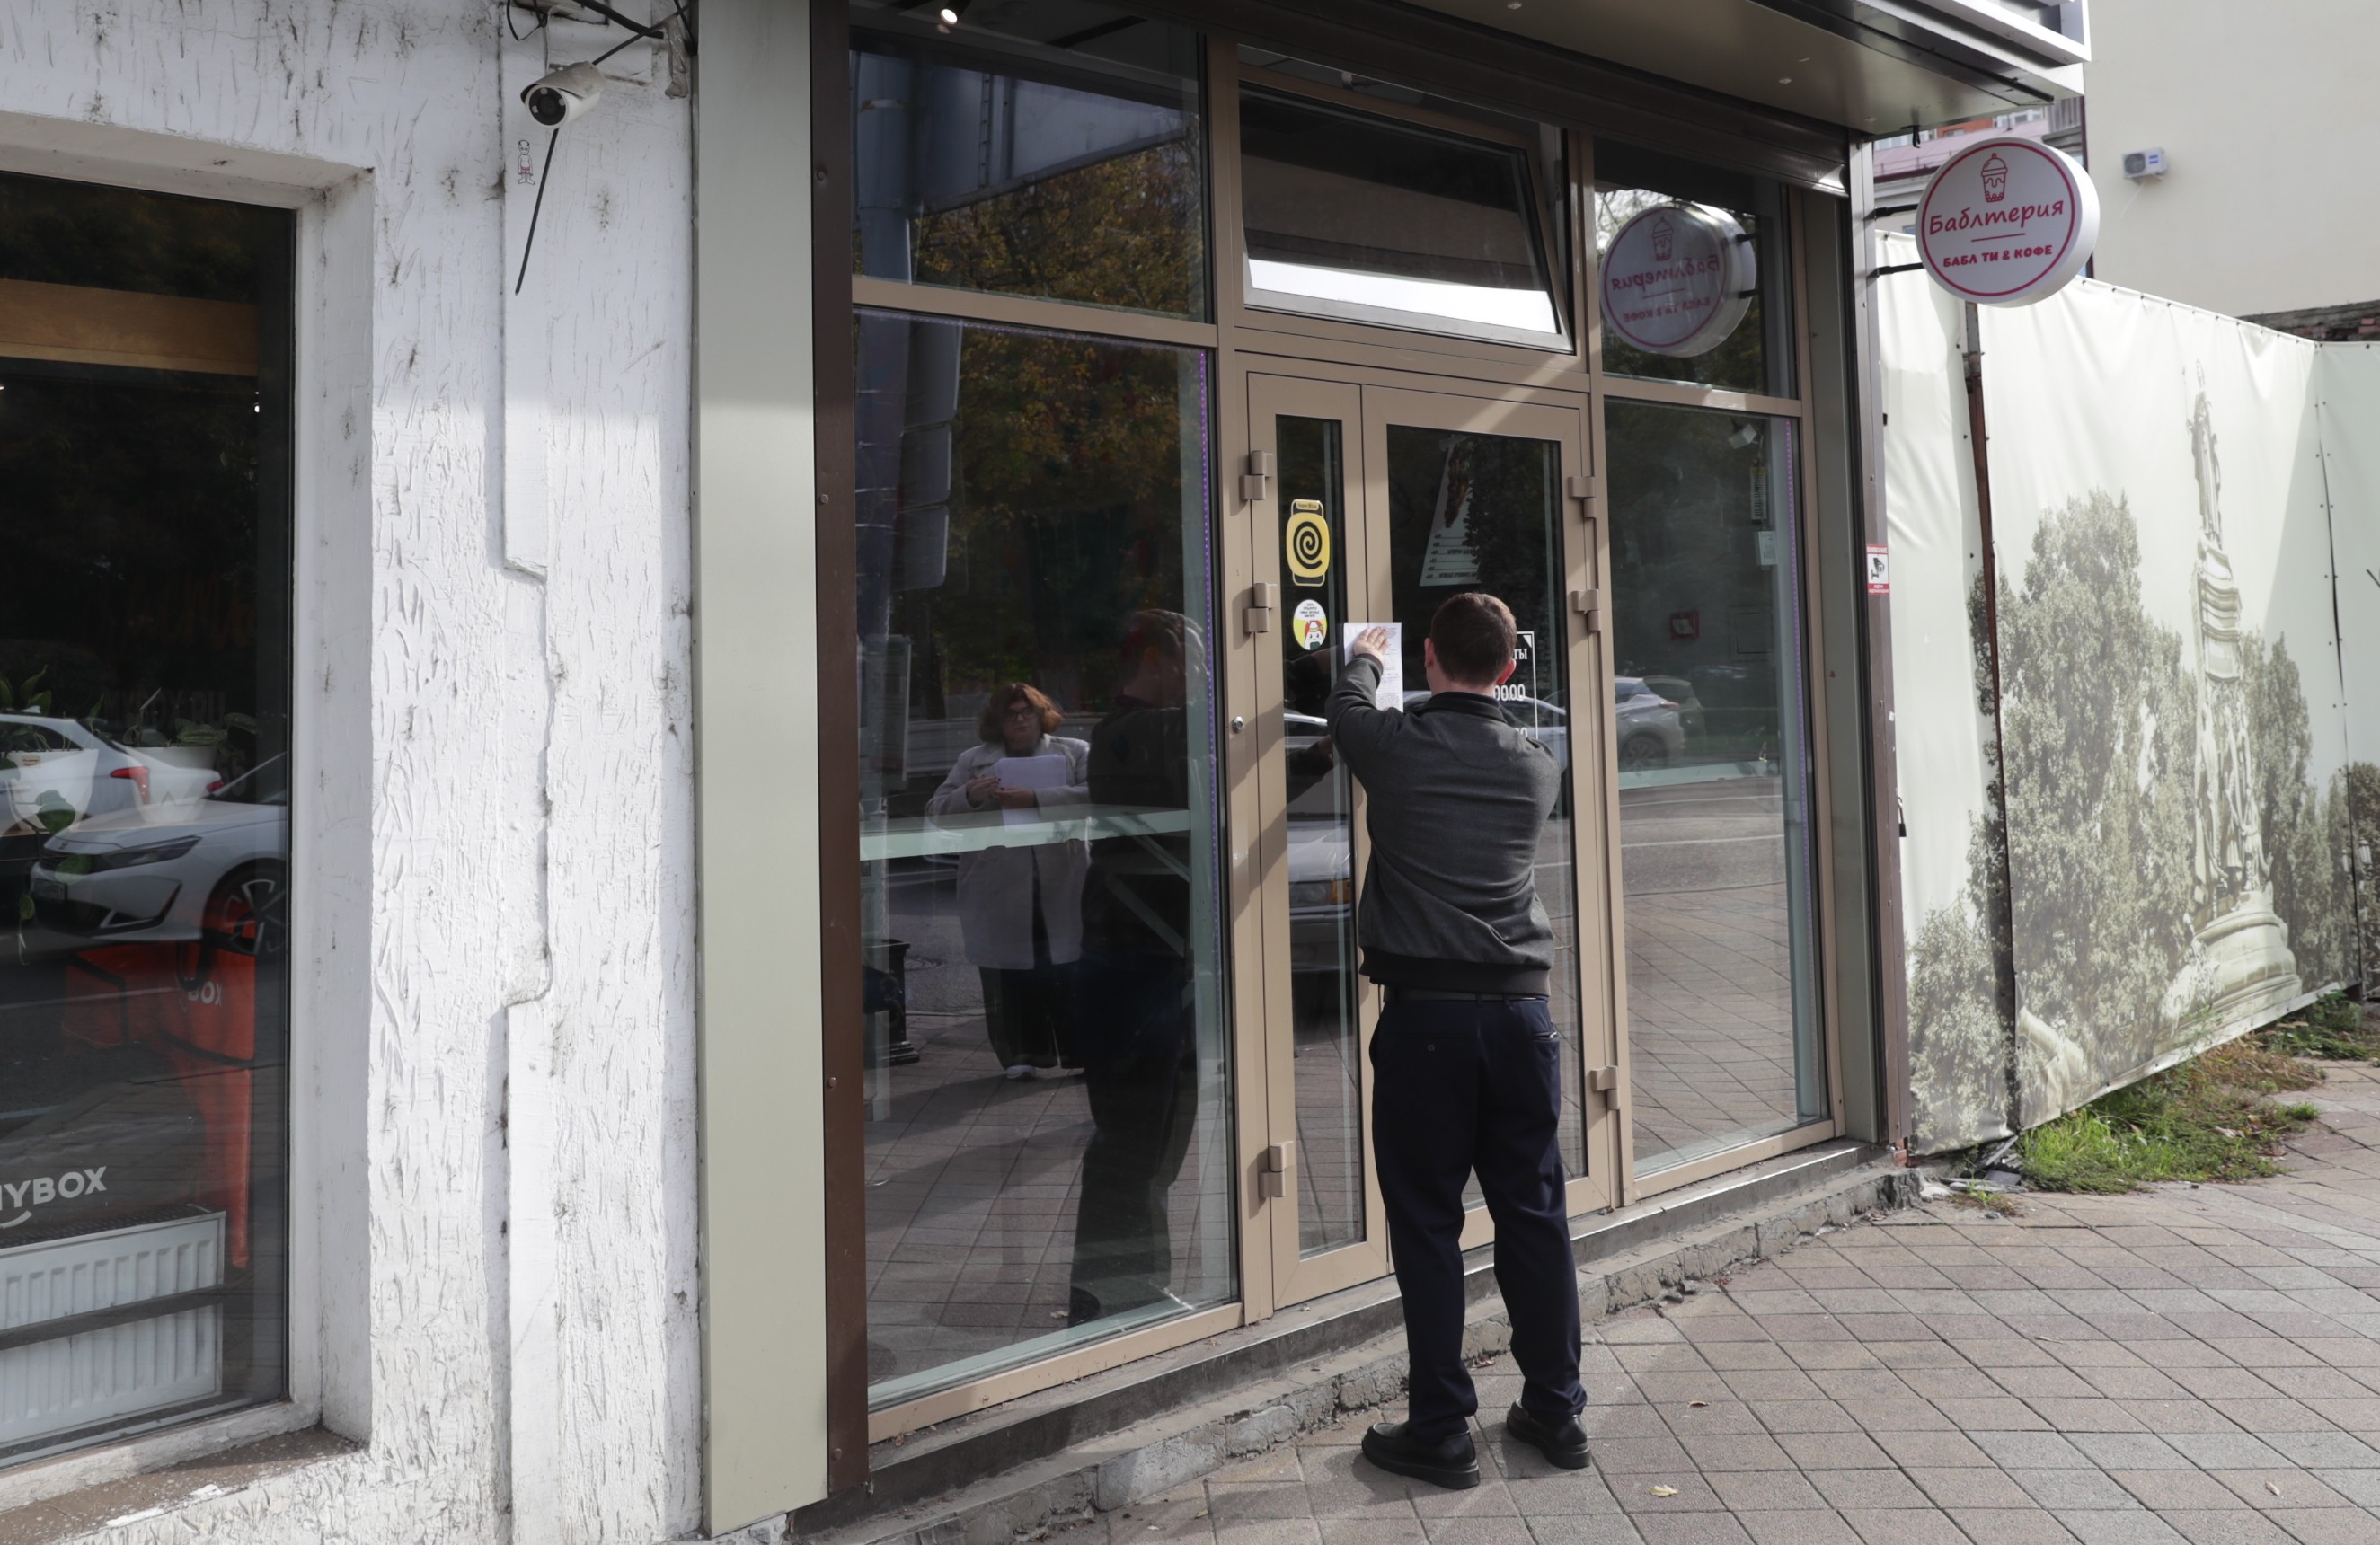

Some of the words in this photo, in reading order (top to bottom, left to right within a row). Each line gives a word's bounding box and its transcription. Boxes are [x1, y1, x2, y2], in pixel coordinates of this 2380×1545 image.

[1929, 200, 2064, 235] Баблтерия
[1942, 254, 1977, 268] БАБЛ
[1982, 252, 1999, 262] ТИ
[2002, 250, 2011, 260] &
[2014, 244, 2053, 259] КОФЕ
[1513, 648, 1528, 660] ТЫ
[0, 1166, 108, 1211] YBOX
